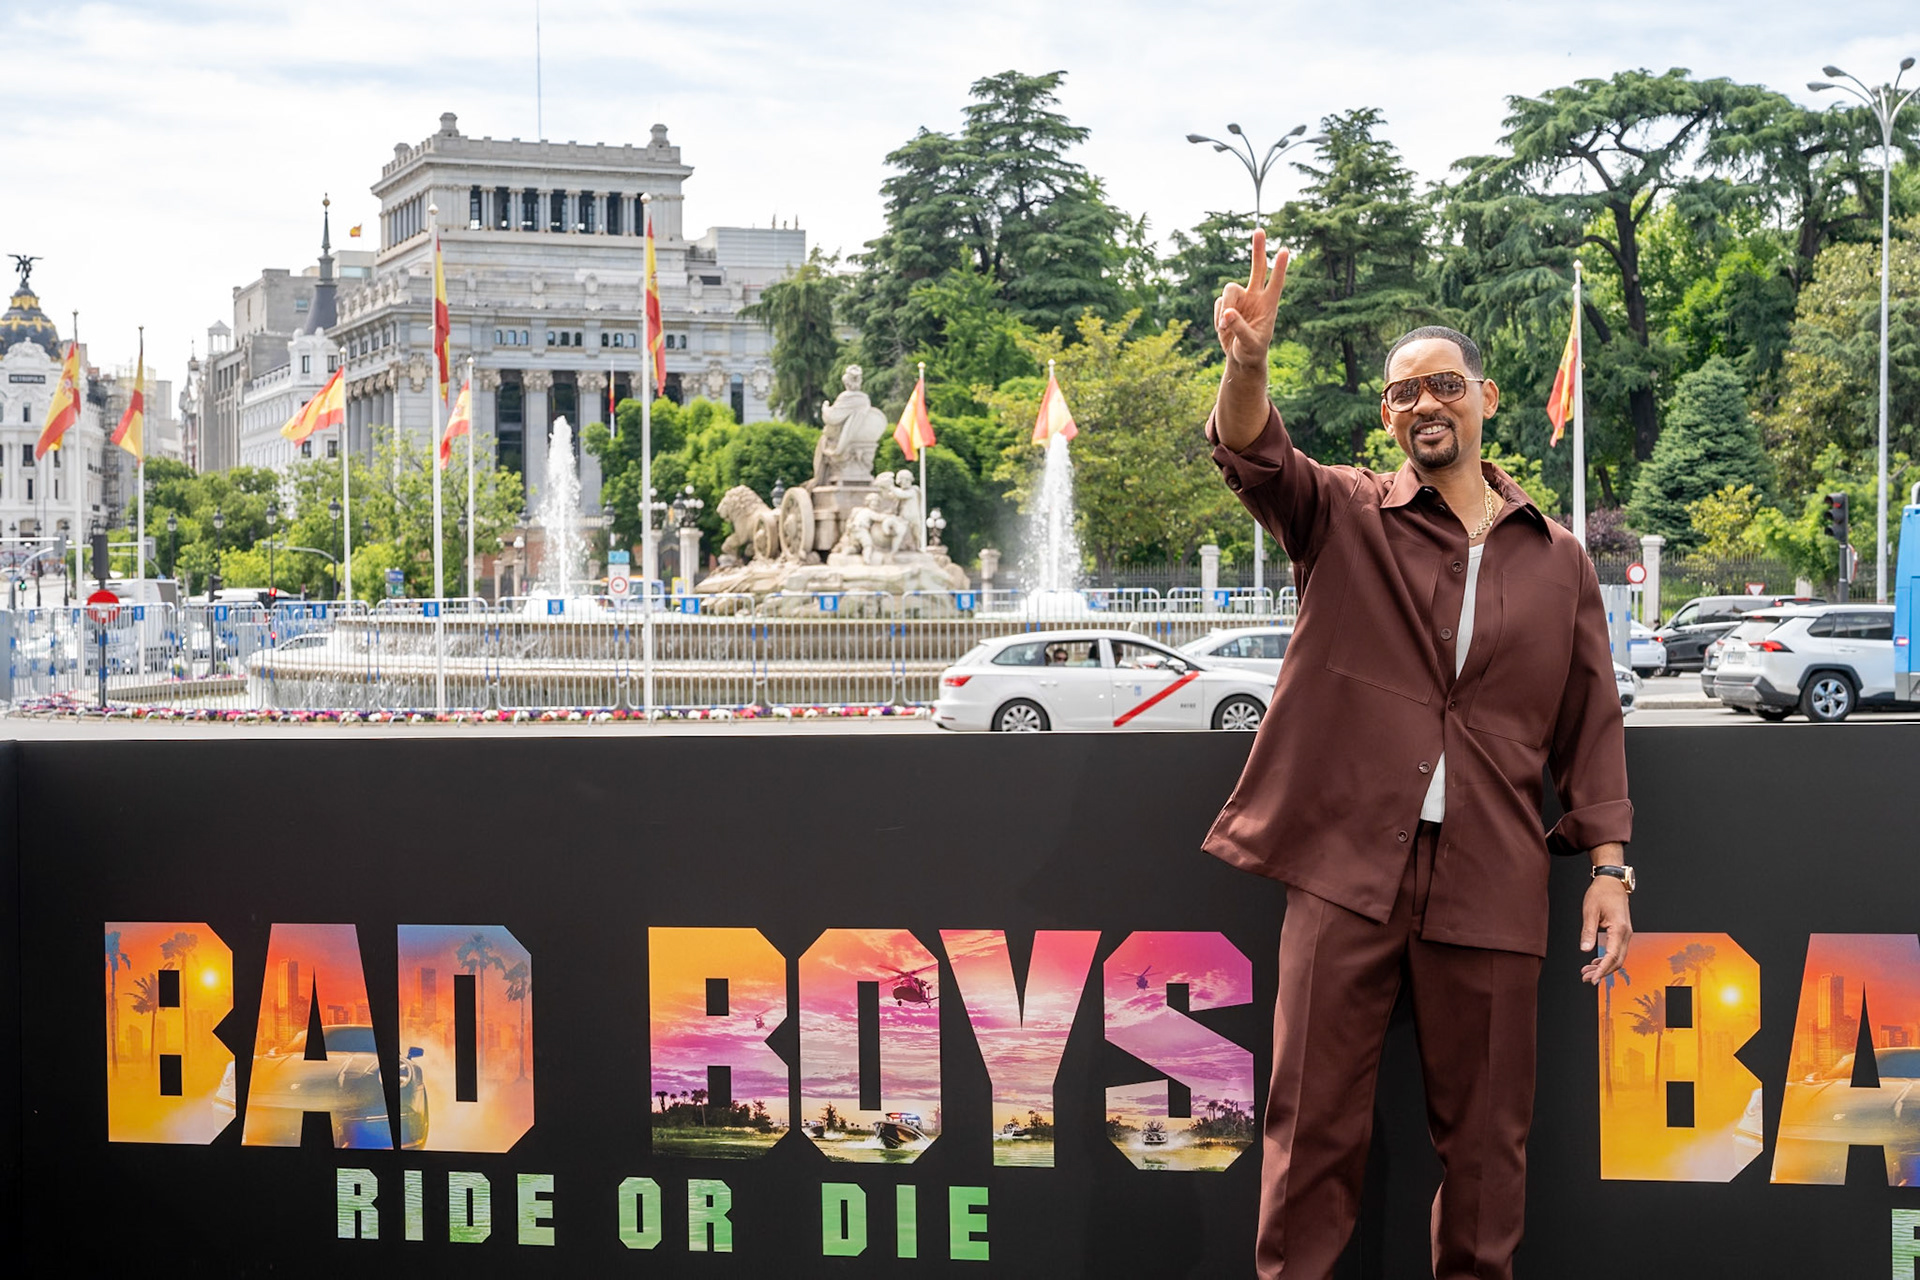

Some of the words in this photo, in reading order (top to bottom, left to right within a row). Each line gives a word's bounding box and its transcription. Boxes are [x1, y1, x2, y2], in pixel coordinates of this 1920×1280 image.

[105, 922, 534, 1153] BAD
[647, 926, 1254, 1171] BOYS
[336, 1168, 555, 1247] RIDE
[618, 1177, 733, 1253] OR
[822, 1182, 990, 1261] DIE
